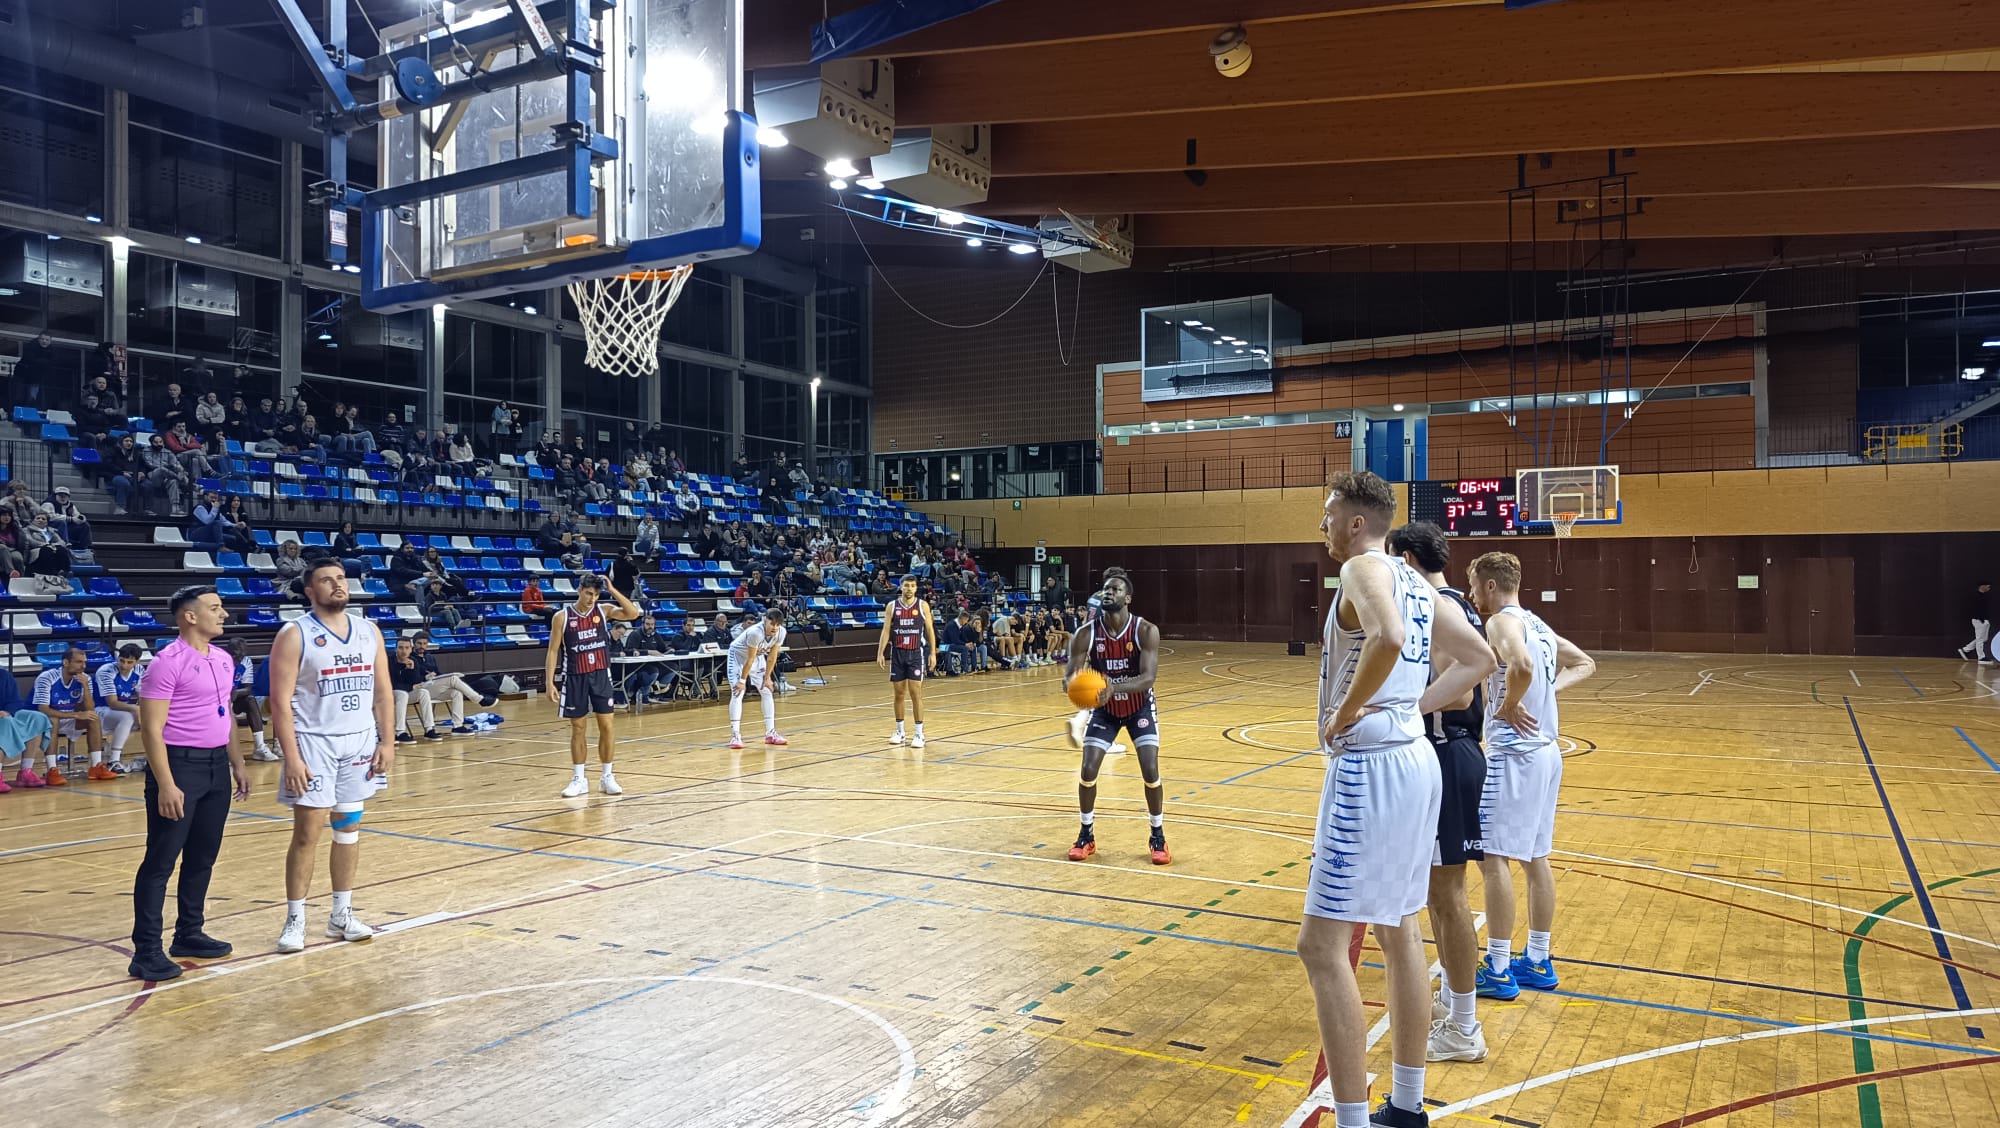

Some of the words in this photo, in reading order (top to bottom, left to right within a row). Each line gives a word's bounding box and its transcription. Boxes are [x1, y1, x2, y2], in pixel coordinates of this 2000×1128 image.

[1459, 481, 1500, 494] 06:44
[1447, 505, 1465, 517] 37
[1476, 501, 1483, 510] 3
[1449, 521, 1455, 530] 1
[1506, 520, 1513, 529] 3
[1034, 546, 1046, 562] B
[578, 628, 598, 640] UESC
[579, 640, 606, 652] Occident
[333, 653, 364, 666] Pujol
[588, 653, 595, 664] 9
[1106, 658, 1129, 670] UESC
[342, 694, 360, 712] 39
